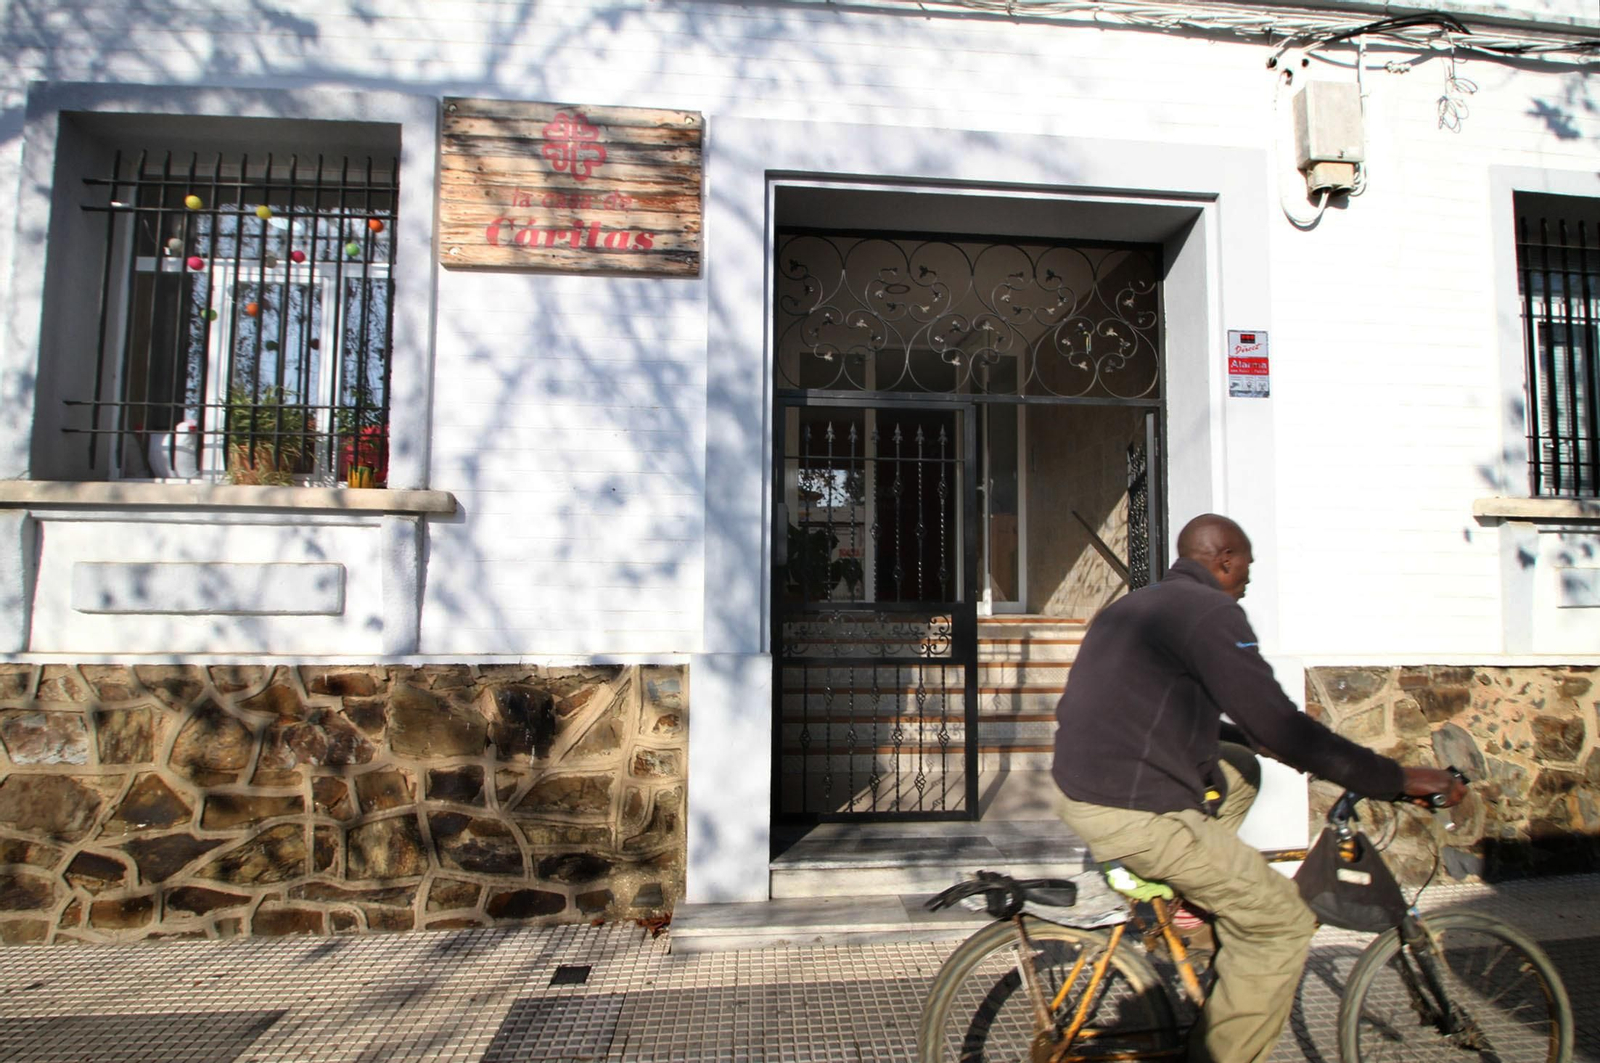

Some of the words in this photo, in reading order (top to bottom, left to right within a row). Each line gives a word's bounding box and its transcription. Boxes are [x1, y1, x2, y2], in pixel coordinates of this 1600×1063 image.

[512, 186, 532, 207] la
[542, 192, 592, 208] casa
[603, 189, 633, 211] de
[486, 215, 655, 249] Cáritas
